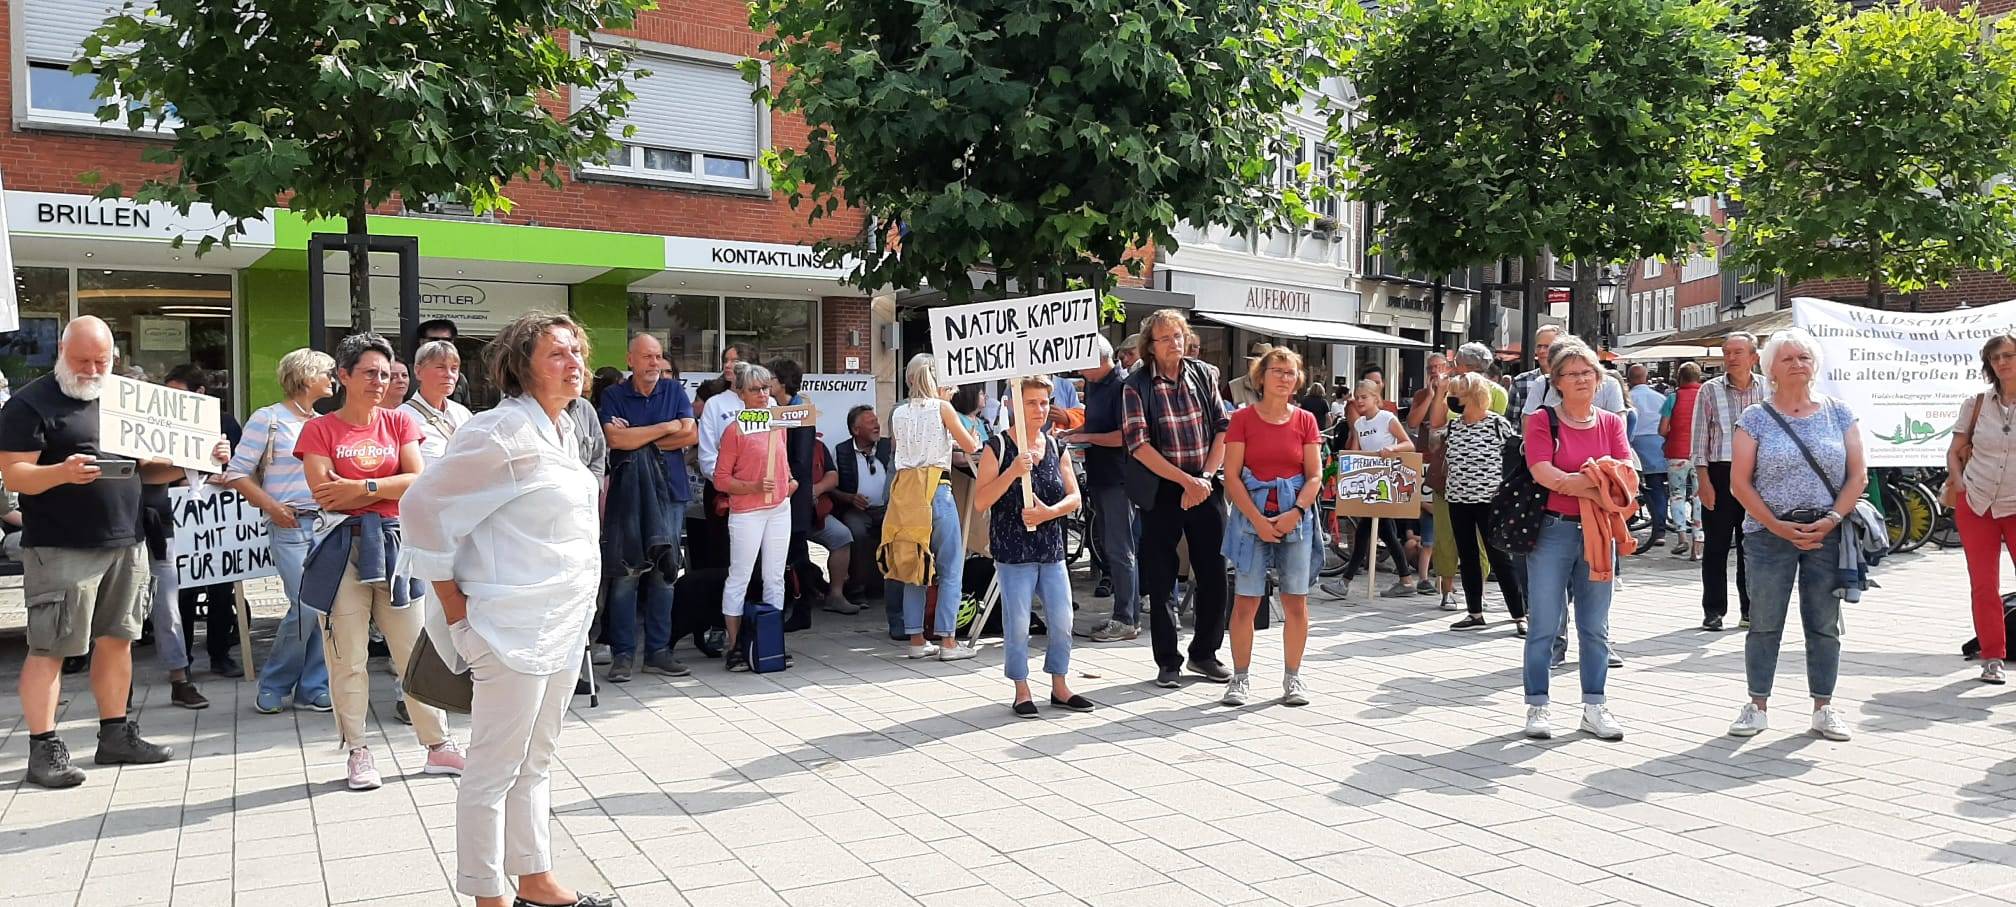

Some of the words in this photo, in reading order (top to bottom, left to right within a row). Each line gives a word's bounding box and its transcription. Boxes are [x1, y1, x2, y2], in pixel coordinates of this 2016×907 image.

[38, 203, 150, 227] BRILLEN
[419, 294, 474, 304] OTTLER
[1246, 287, 1310, 312] AUFEROTH
[945, 308, 1019, 341] NATUR
[1028, 298, 1092, 329] KAPUTT
[1849, 311, 1982, 326] WALDSCHUTZ
[1808, 323, 1905, 340] Klimaschutz
[1909, 330, 1939, 341] und
[947, 341, 1014, 376] MENSCH
[1029, 333, 1096, 366] KAPUTT
[1849, 348, 1973, 366] Einschlagstopp
[1827, 368, 1851, 381] alle
[1856, 367, 1959, 384] alten/großen
[801, 381, 867, 391] RTENSCHUTZ
[120, 380, 206, 424] PLANET
[147, 416, 172, 429] OVER
[782, 410, 809, 420] STOPP
[120, 419, 204, 460] PROFIT
[336, 445, 366, 459] Hard
[368, 444, 395, 458] Rock
[194, 527, 225, 551] MIT
[236, 523, 269, 541] UNS
[176, 553, 214, 585] FÜR
[223, 549, 244, 577] DIE
[249, 546, 276, 571] NA
